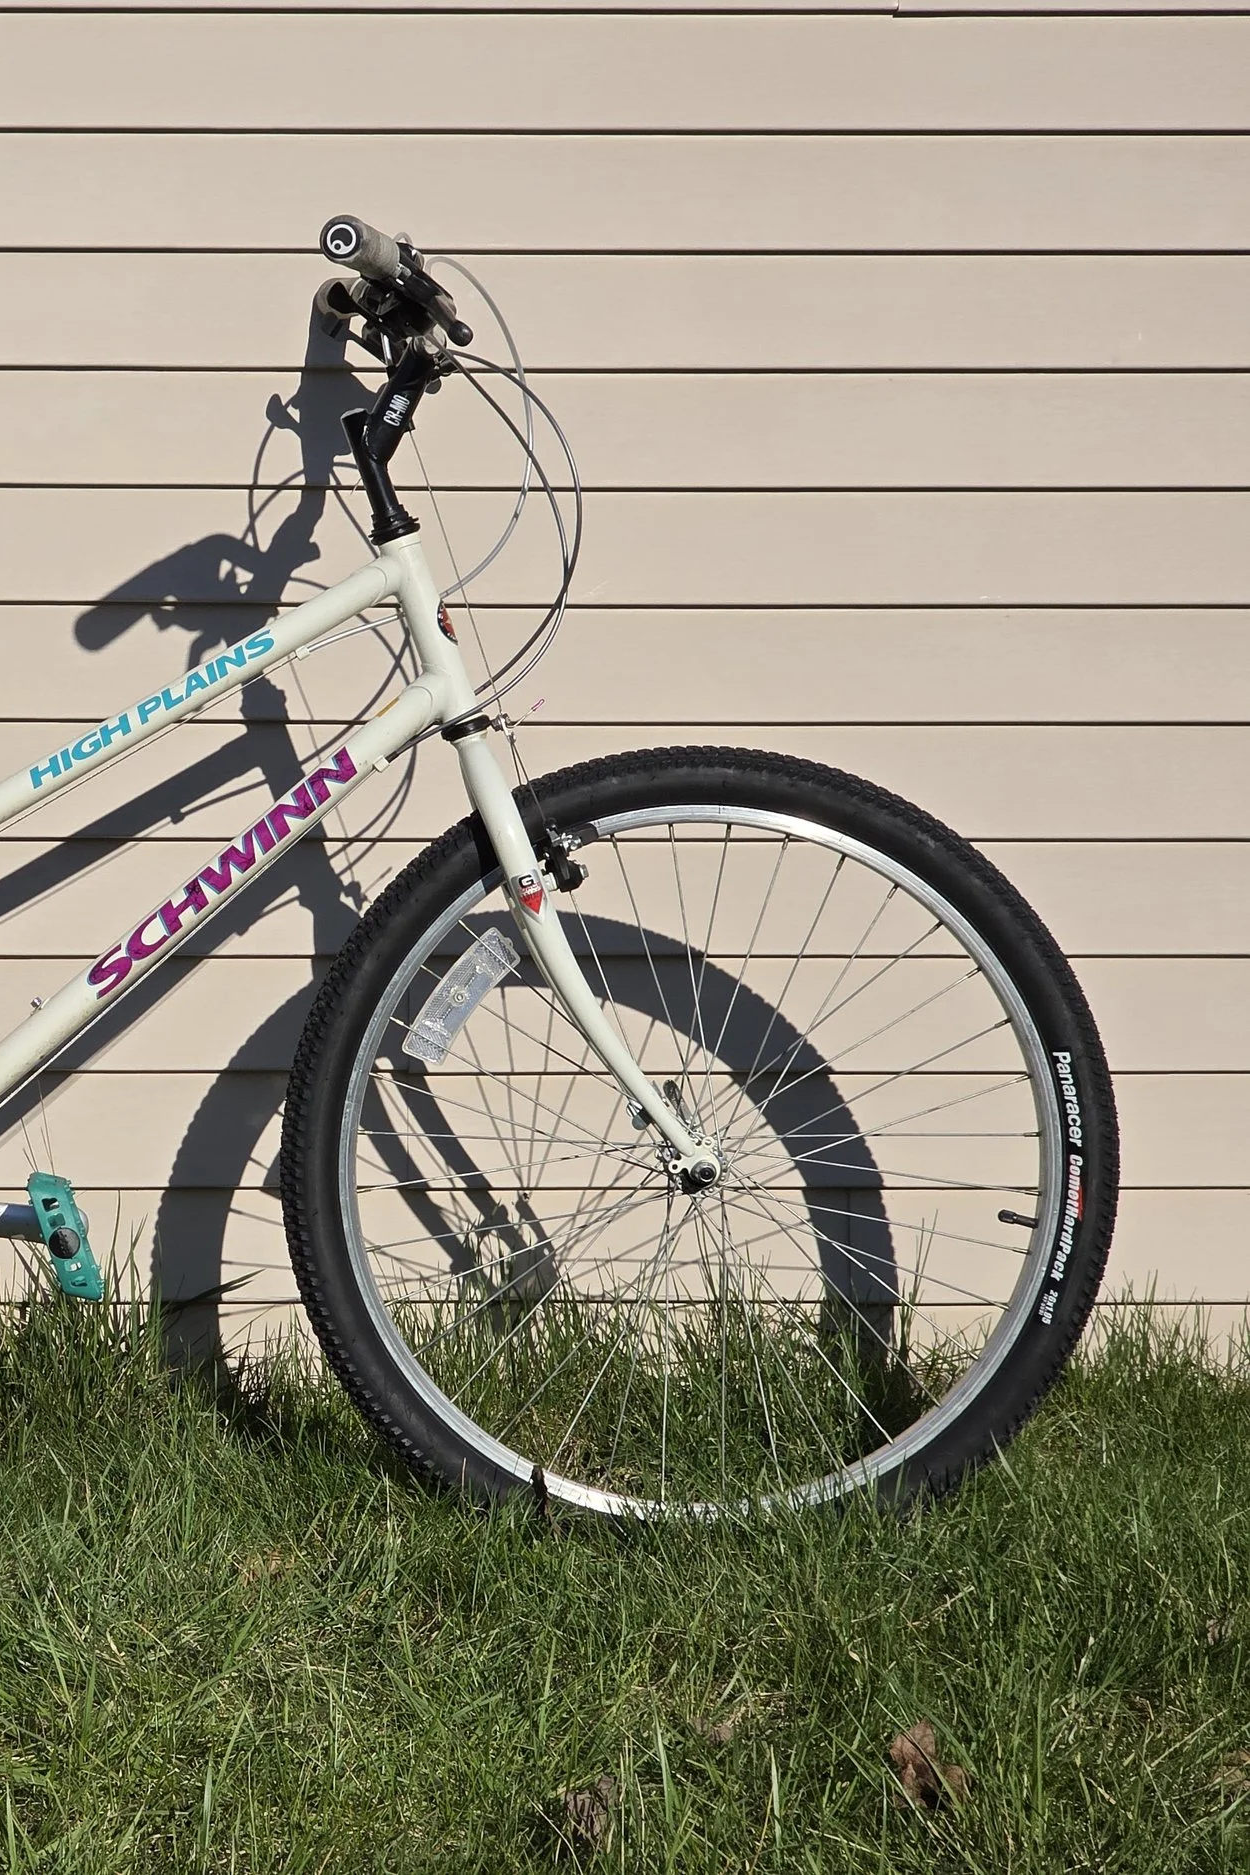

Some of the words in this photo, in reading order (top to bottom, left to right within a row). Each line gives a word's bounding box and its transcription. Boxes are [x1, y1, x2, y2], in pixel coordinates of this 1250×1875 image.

[383, 394, 410, 427] CR-MO
[30, 714, 132, 789] HIGH
[137, 629, 275, 726] PLAINS
[87, 746, 358, 1000] SCHWINN
[1052, 1051, 1083, 1148] Panaracer
